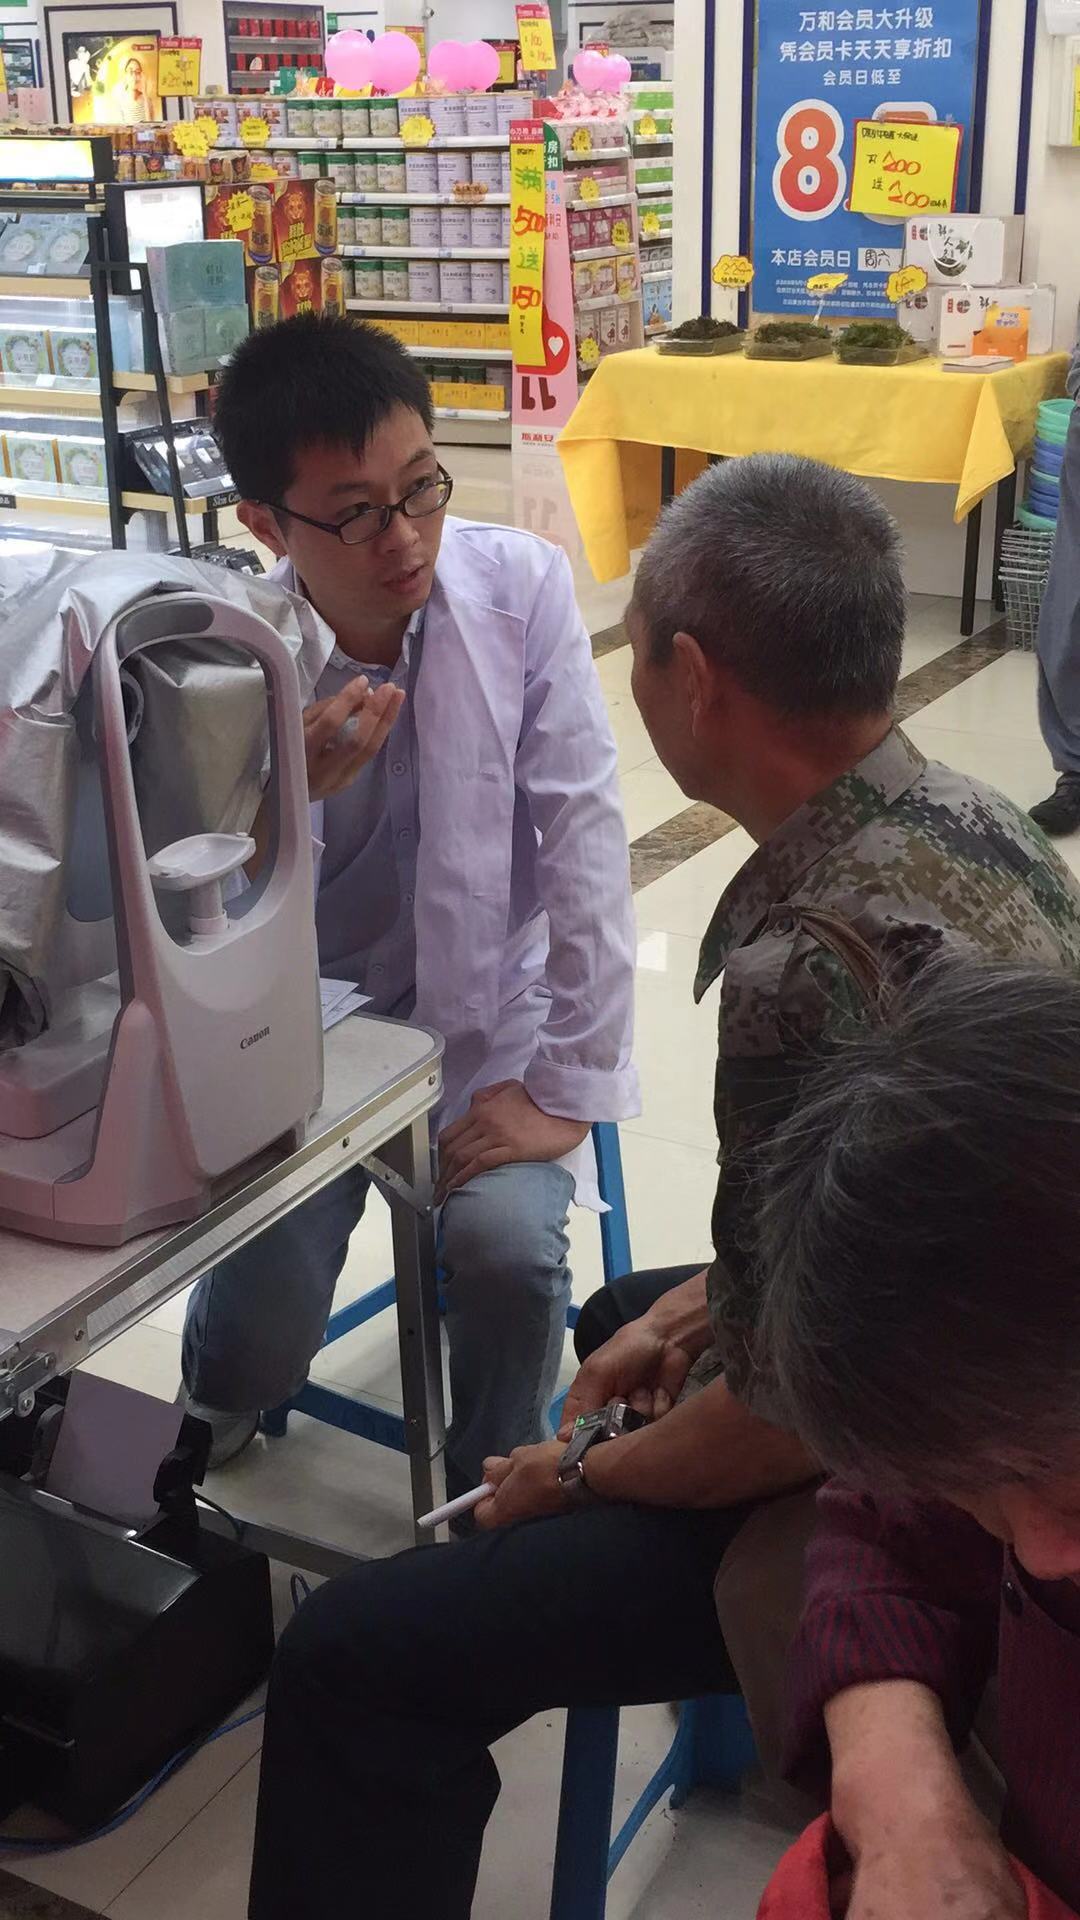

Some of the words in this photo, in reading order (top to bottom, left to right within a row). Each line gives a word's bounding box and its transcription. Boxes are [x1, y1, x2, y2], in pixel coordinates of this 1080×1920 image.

[799, 7, 934, 31] 万和会员大升级
[779, 38, 952, 62] 凭会员卡天天享折扣
[823, 69, 902, 86] 会员日低至
[770, 248, 851, 268] 本店会员日
[864, 248, 891, 269] 周六
[512, 285, 541, 309] 150
[240, 1026, 270, 1050] Canon
